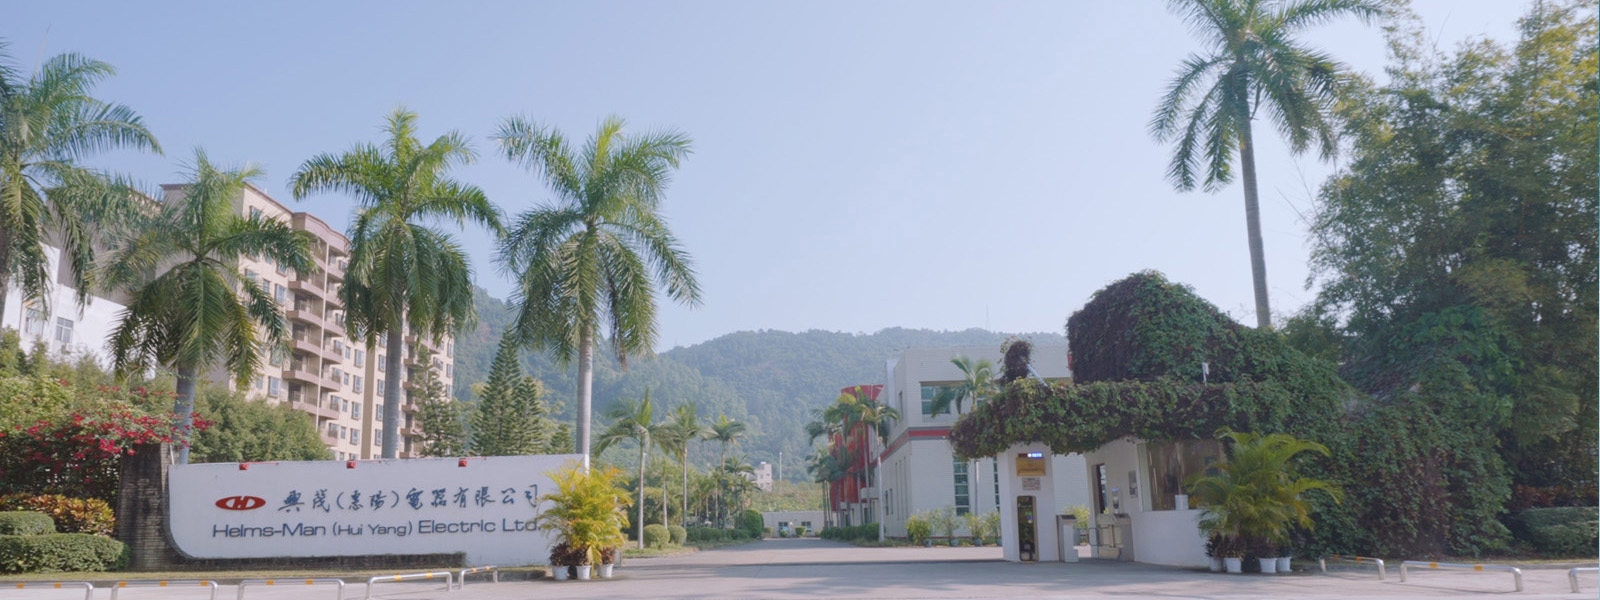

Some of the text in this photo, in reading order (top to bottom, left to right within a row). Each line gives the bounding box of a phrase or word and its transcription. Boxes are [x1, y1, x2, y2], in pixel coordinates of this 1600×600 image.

[212, 518, 541, 538] Helms-Man (Hui Yang) Electric Ltd.
